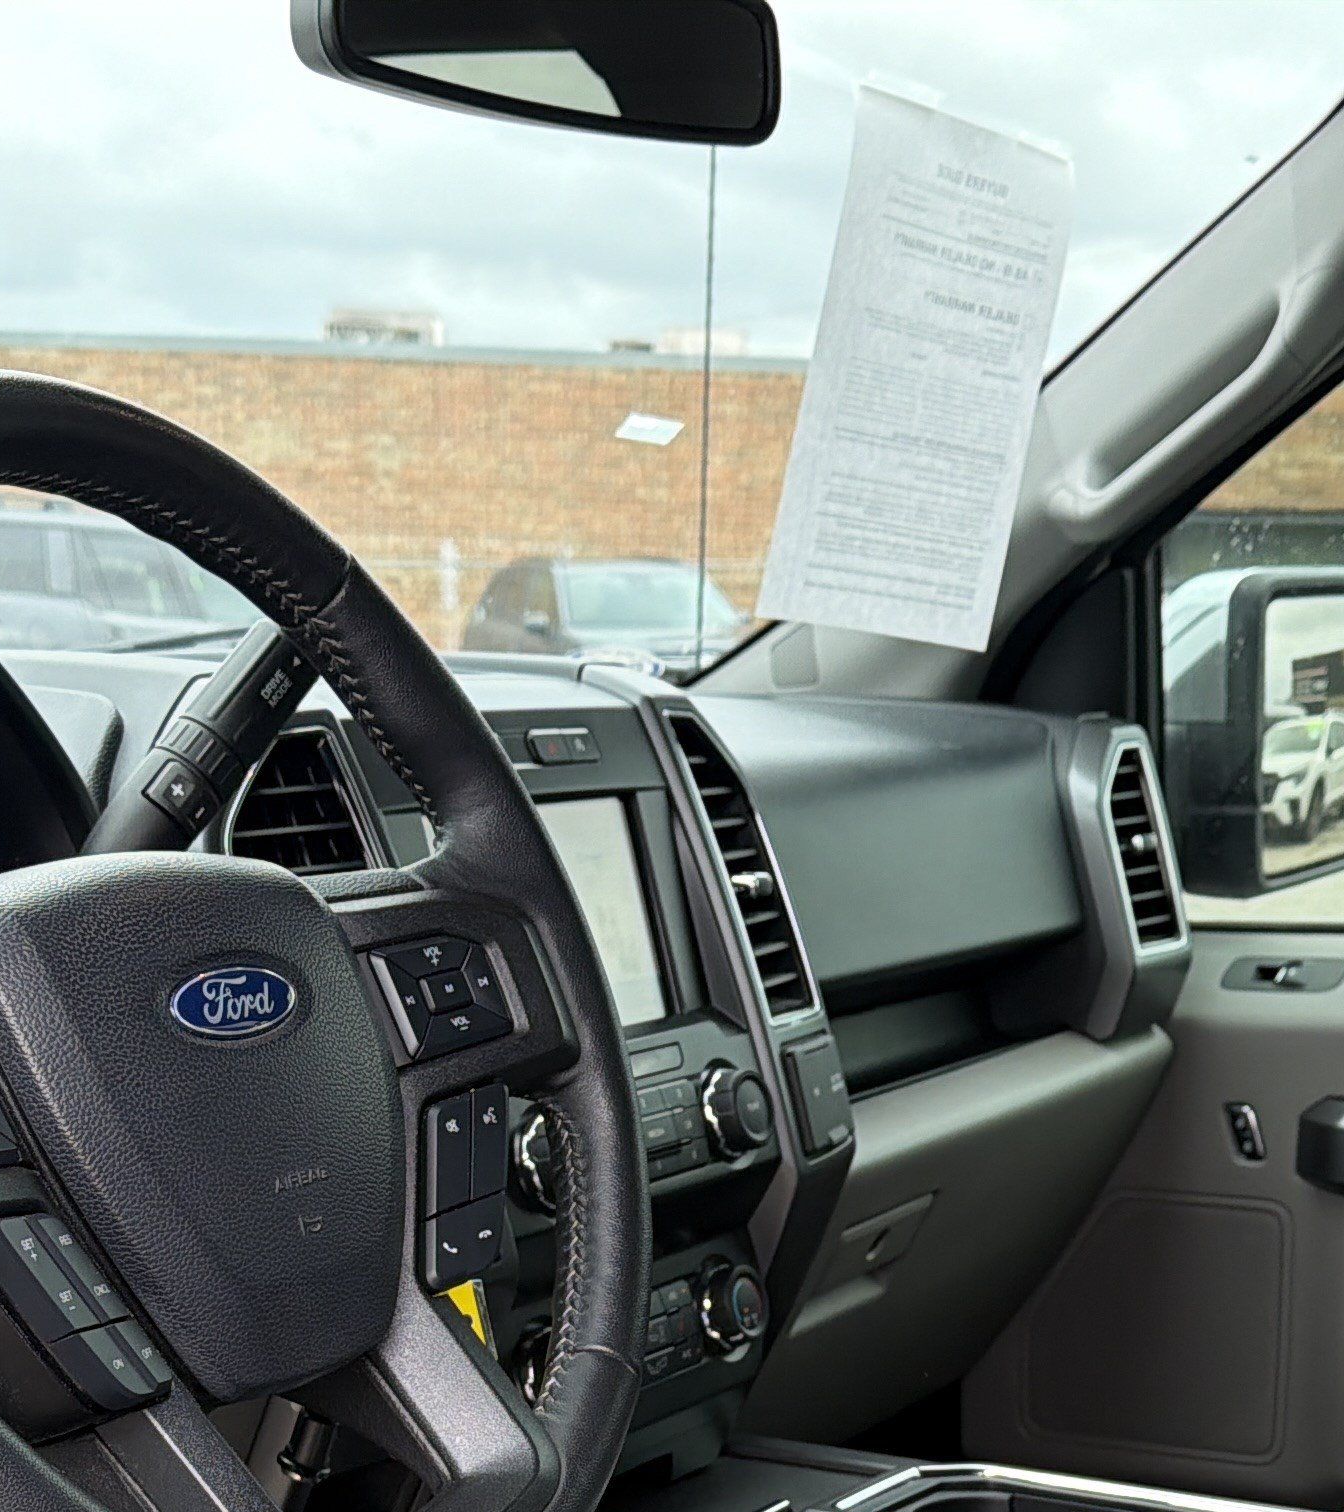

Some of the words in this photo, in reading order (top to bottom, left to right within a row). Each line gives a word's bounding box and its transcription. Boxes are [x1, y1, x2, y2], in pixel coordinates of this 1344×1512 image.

[260, 668, 286, 700] DRIVE
[268, 676, 293, 708] MODE
[423, 945, 443, 958] VOL
[202, 974, 275, 1025] Ford
[450, 1015, 471, 1027] VOL
